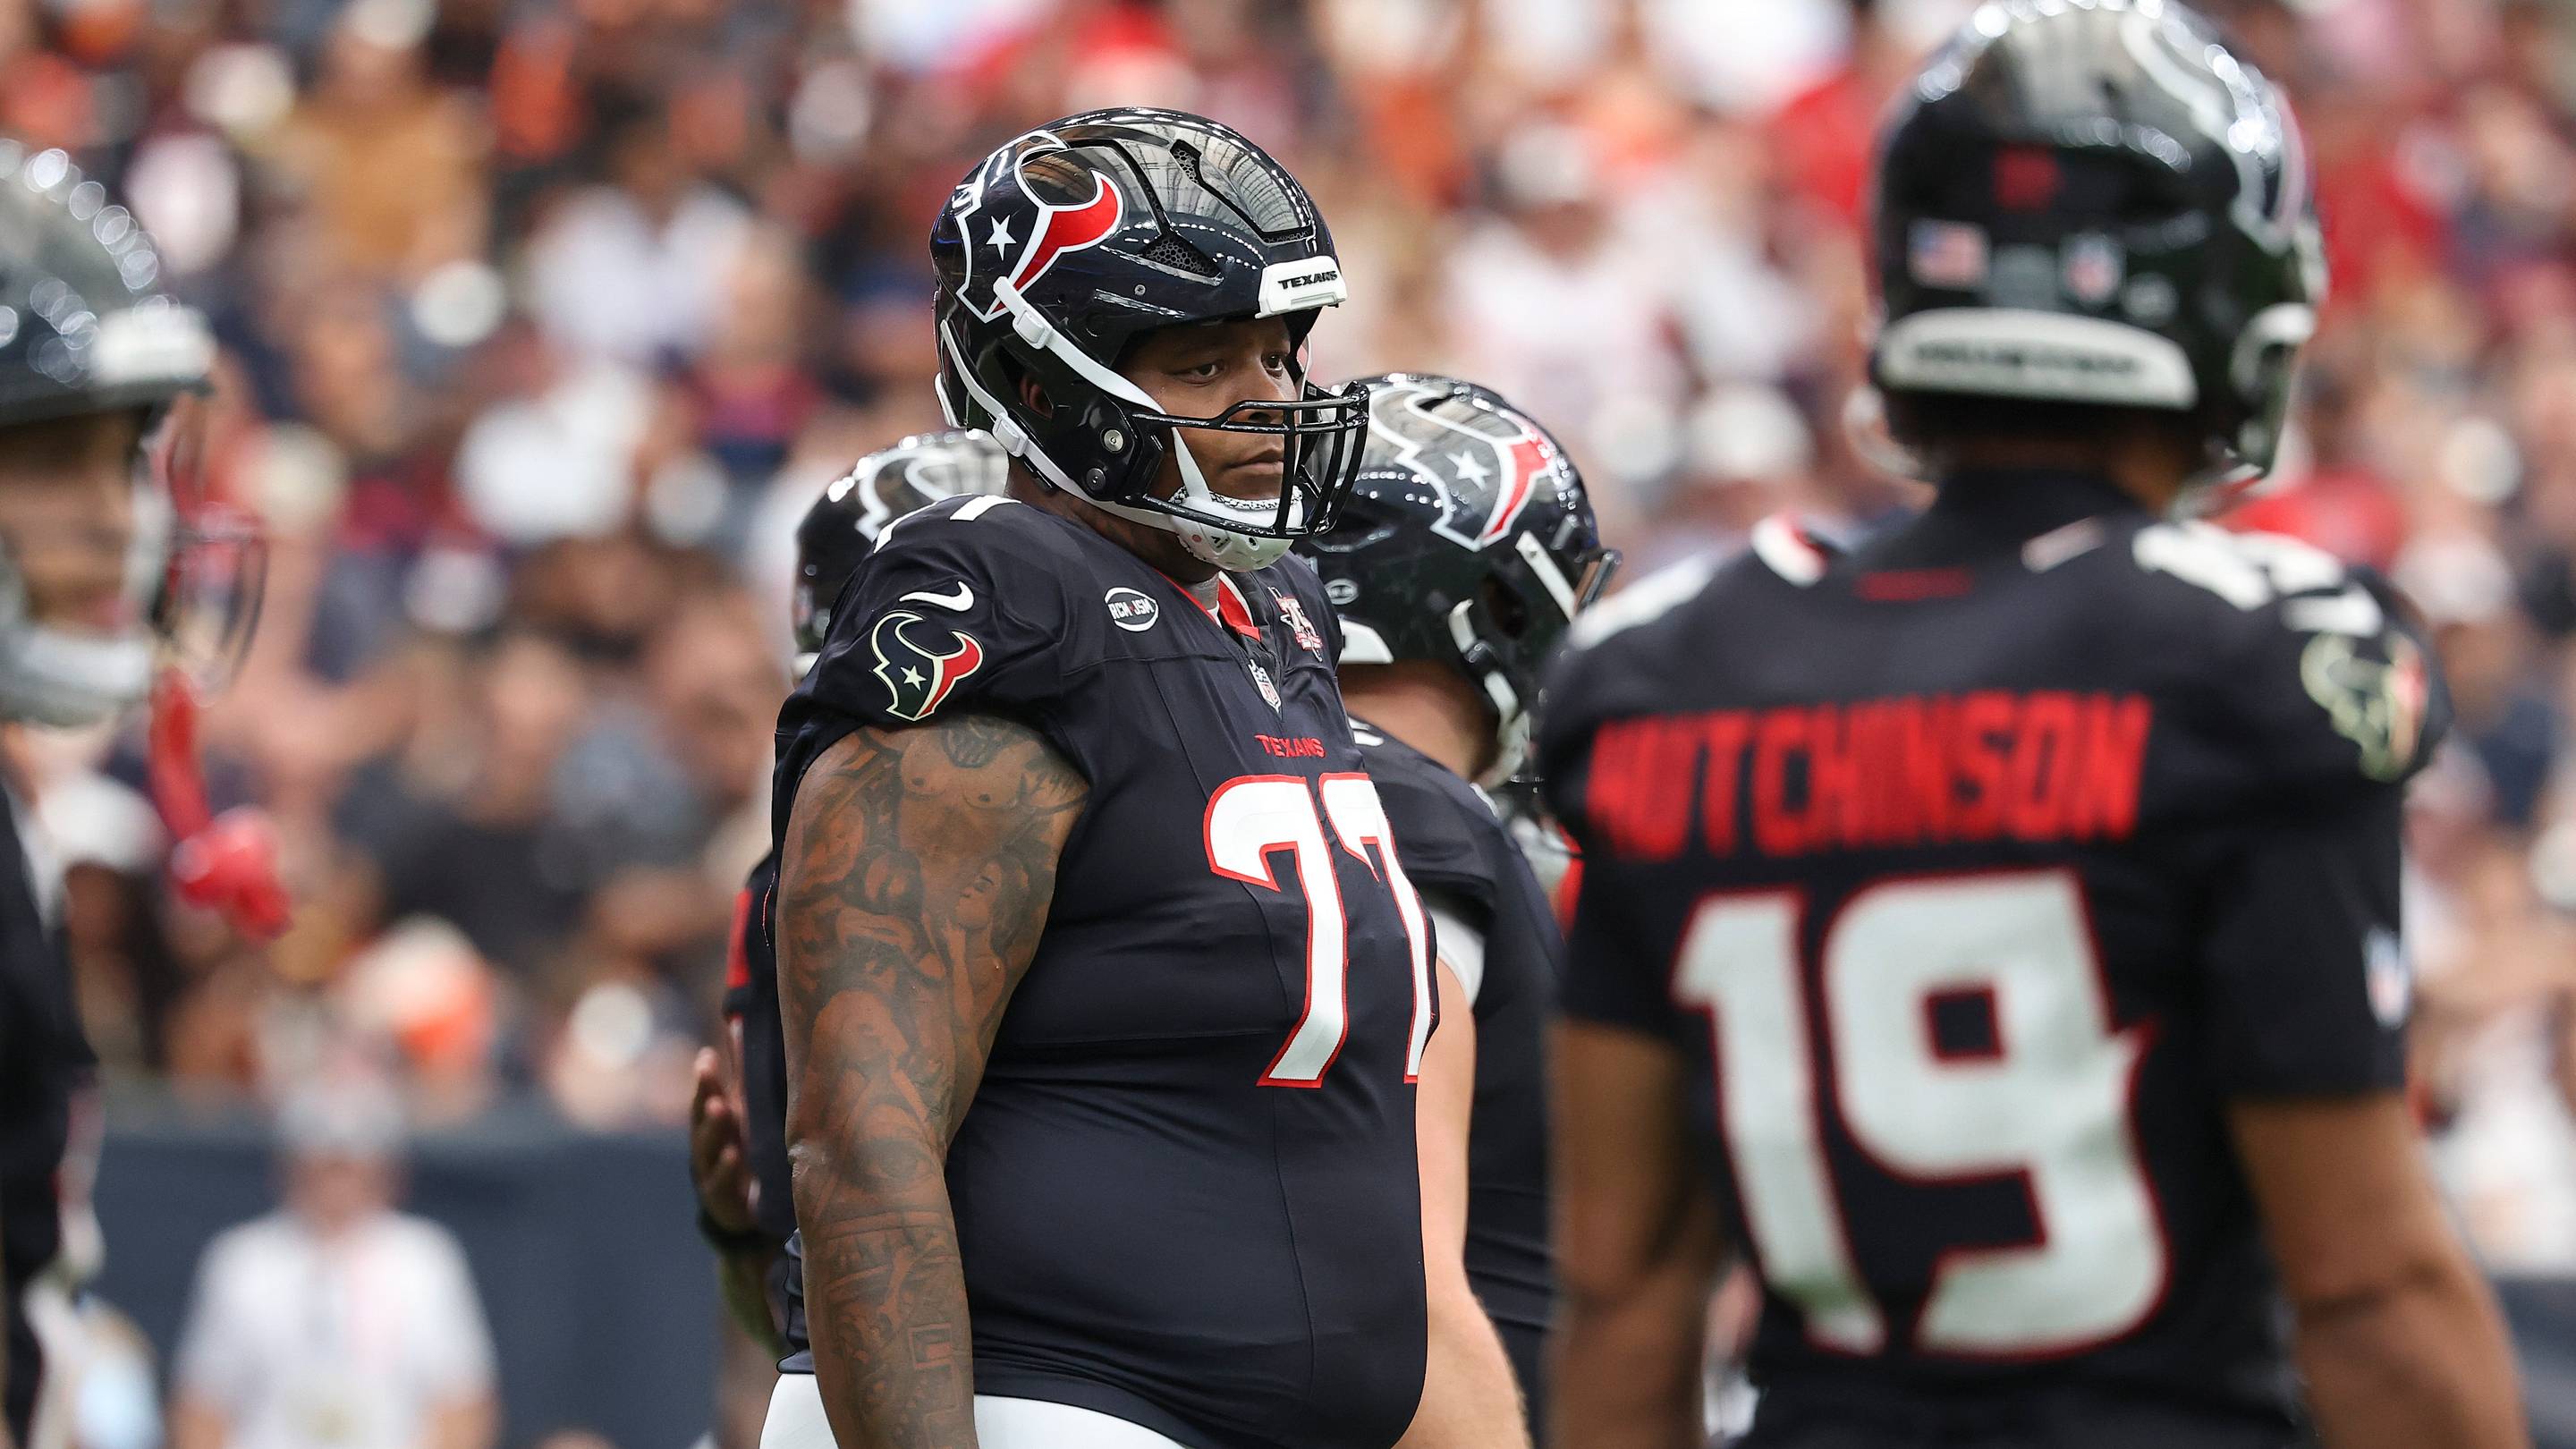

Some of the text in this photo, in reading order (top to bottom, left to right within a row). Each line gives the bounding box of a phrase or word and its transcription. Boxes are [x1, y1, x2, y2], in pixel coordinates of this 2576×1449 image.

[1277, 270, 1338, 290] TEXANS
[1254, 734, 1326, 758] TEXANS
[1587, 691, 2152, 861] HUTCHINSON
[1203, 772, 1433, 1089] 77
[1669, 866, 2173, 1360] 19
